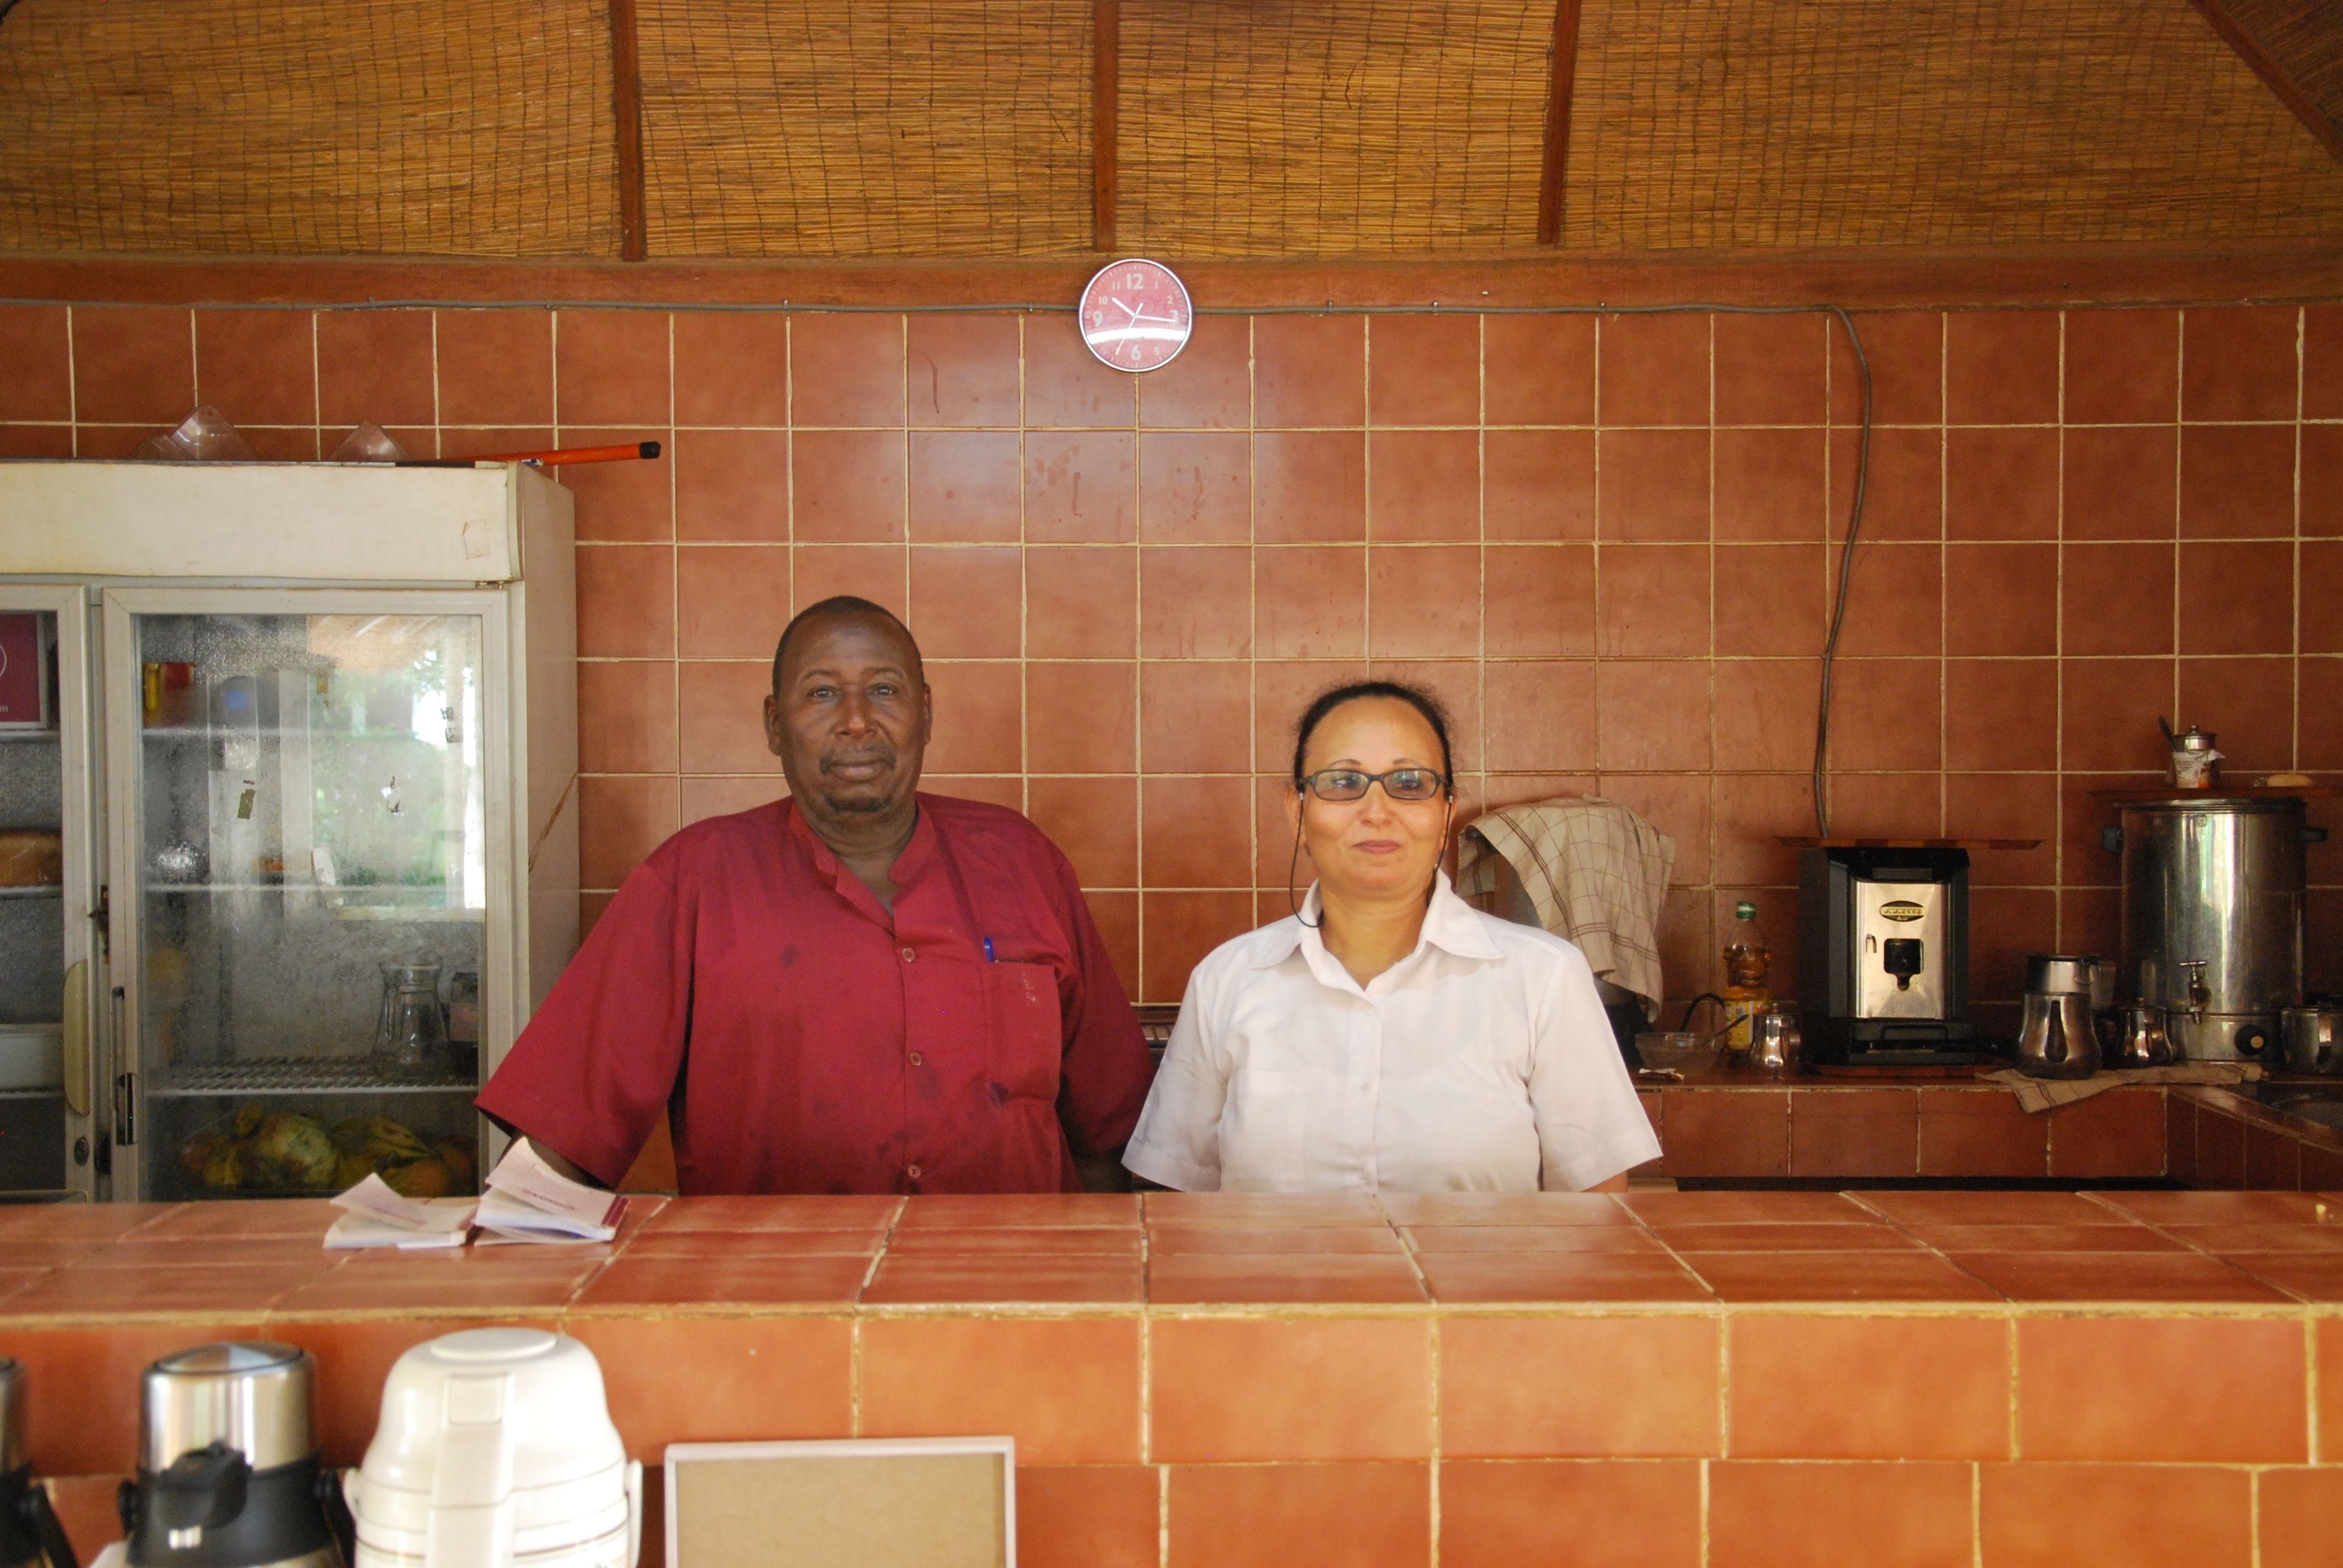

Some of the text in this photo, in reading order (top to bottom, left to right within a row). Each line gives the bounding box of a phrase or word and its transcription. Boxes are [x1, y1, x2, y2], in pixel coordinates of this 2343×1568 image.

[1112, 281, 1120, 290] 11
[1126, 273, 1144, 290] 12
[1154, 281, 1158, 290] 1
[1099, 296, 1108, 305] 10
[1167, 295, 1173, 304] 2
[1093, 311, 1103, 327] 9
[1169, 310, 1179, 325] 3
[1131, 344, 1142, 361] 6
[1154, 347, 1160, 356] 5
